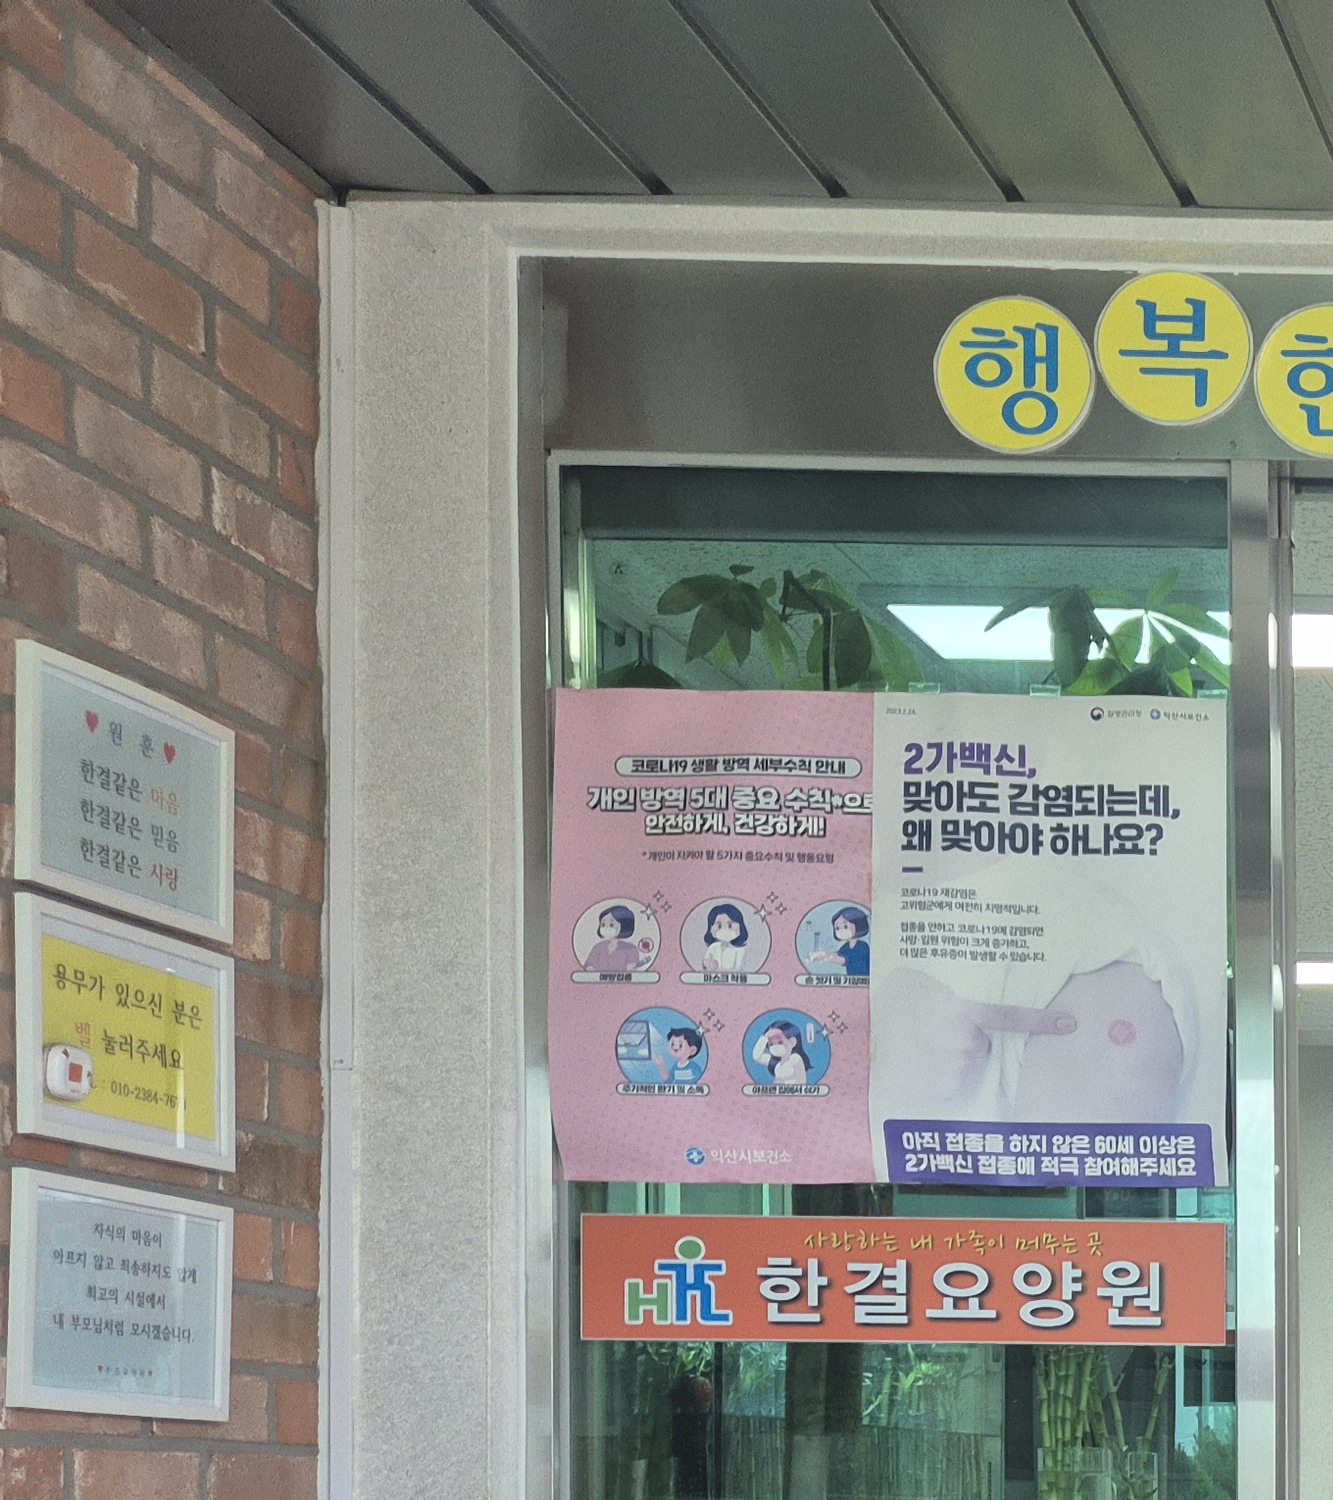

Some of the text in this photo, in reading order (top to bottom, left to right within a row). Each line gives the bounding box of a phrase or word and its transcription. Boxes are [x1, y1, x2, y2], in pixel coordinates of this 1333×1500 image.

[631, 759, 687, 774] 코로나19
[722, 758, 750, 772] 방역
[753, 759, 812, 774] 세부수칙
[815, 759, 846, 775] 안내
[903, 741, 1036, 779] 2가백신,
[80, 759, 180, 816] 한결같은 마음
[587, 786, 781, 811] 개인 방역 5대 중요
[902, 779, 1181, 820] 맞아도 감염되는데,
[80, 798, 179, 853] 한결같은 믿음
[644, 813, 826, 837] 안전하게, 건강하게!
[900, 819, 1164, 856] 왜 맞아야 하나요?
[80, 837, 178, 892] 한결같은 사랑
[900, 887, 938, 898] 코로나19
[53, 963, 202, 1029] 용무가 있으신 분은
[101, 1029, 184, 1070] 눌러주세요
[902, 1131, 1196, 1155] 아직 접종을 하지 않은 60세 이상은
[711, 1150, 792, 1165] 익산시보건소
[905, 1153, 1197, 1178] 2가백신 접종에 적극 참여해주세요
[93, 1223, 162, 1248] 자식의 마음이
[804, 1228, 1104, 1256] 사랑하는 내 가족이 머무는 곳
[53, 1248, 87, 1269] 아프지
[121, 1258, 172, 1279] 죄송하지도
[87, 1284, 166, 1310] 최고의 시설에서
[756, 1256, 1164, 1328] 한결요양원
[53, 1313, 65, 1331] 내
[72, 1315, 125, 1337] 부모님처럼
